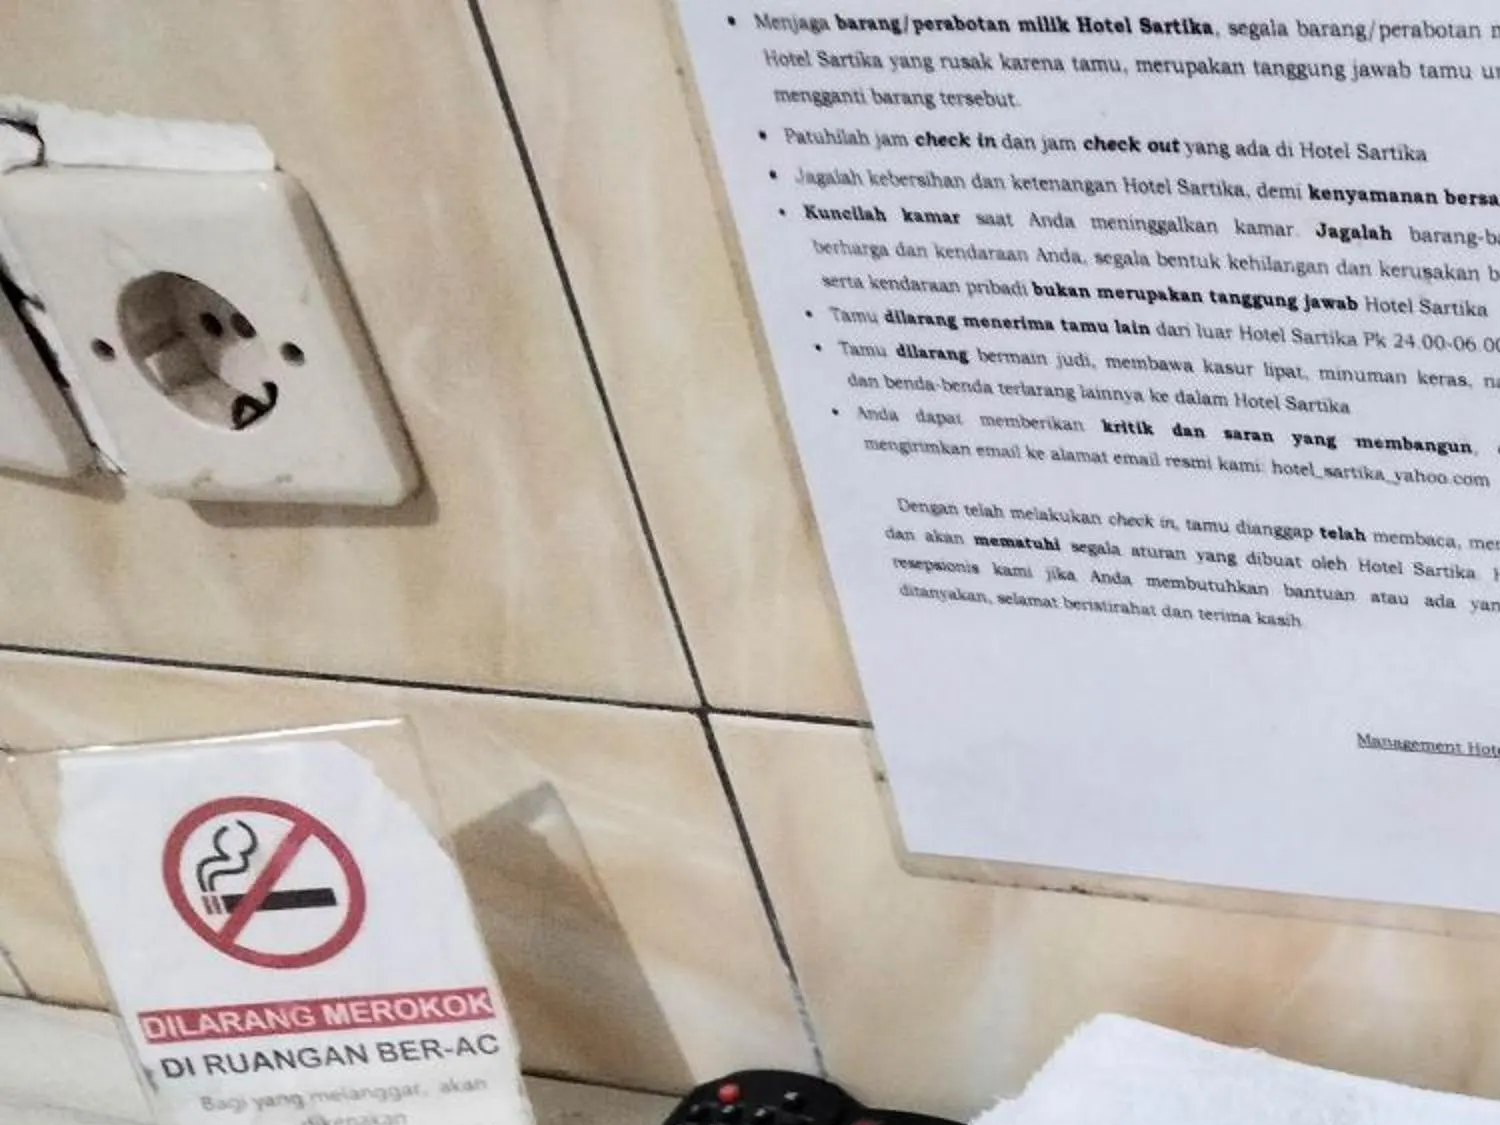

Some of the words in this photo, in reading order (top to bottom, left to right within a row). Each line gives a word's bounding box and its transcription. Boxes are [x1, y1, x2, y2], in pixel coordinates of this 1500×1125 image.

[753, 12, 831, 36] Menjaga
[834, 13, 1011, 36] barang/perabotan
[1017, 15, 1071, 33] milik
[1075, 15, 1133, 34] Hotel
[1138, 16, 1222, 36] Sartika,
[1227, 18, 1289, 41] segala
[1295, 19, 1482, 43] barang/perabotan
[763, 49, 813, 68] Hotel
[816, 49, 884, 69] Sartika
[889, 55, 936, 74] yang
[939, 51, 994, 71] rusak
[998, 52, 1065, 72] karena
[1071, 56, 1129, 75] tamu,
[1135, 56, 1246, 79] merupakan
[1252, 59, 1347, 83] tanggung
[1351, 59, 1412, 83] jawab
[1419, 63, 1472, 80] tamu
[870, 87, 937, 111] barang
[875, 133, 910, 150] jam
[914, 131, 972, 148] check
[976, 132, 998, 149] in
[1001, 132, 1037, 151] dan
[1041, 137, 1077, 155] jam
[1083, 135, 1142, 153] check
[1147, 138, 1181, 154] out
[1183, 141, 1232, 161] yang
[1235, 139, 1271, 158] ada
[1275, 139, 1294, 158] di
[1299, 141, 1351, 160] Hotel
[1356, 143, 1428, 162] Sartika
[866, 169, 966, 189] kebersihan
[970, 172, 1006, 190] dan
[1010, 173, 1118, 197] ketenangan
[1122, 176, 1173, 196] Hotel
[1176, 177, 1252, 199] Sartika,
[1256, 181, 1303, 201] demi
[1307, 183, 1439, 206] kenyamanan
[803, 204, 887, 223] Kuncilah
[901, 207, 961, 225] kamar
[975, 212, 1014, 228] saat
[1029, 211, 1076, 229] Anda
[1090, 214, 1219, 237] meninggalkan
[1315, 222, 1393, 244] Jagalah
[894, 241, 929, 259] dan
[933, 243, 1029, 263] kendaraan
[1093, 249, 1151, 270] segala
[1155, 250, 1221, 270] bentuk
[1335, 258, 1373, 277] dan
[1378, 259, 1481, 283] kerusakan
[867, 274, 961, 294] kendaraan
[1031, 280, 1091, 299] bukan
[1096, 286, 1204, 305] merupakan
[1209, 290, 1299, 313] tanggung
[1303, 293, 1359, 313] jawab
[1364, 295, 1414, 314] Hotel
[1419, 298, 1489, 318] Sartika
[884, 309, 959, 331] dilarang
[962, 315, 1055, 331] menerima
[1060, 319, 1109, 334] tamu
[1113, 319, 1151, 336] lain
[1239, 325, 1287, 344] Hotel
[1290, 327, 1358, 347] Sartika
[1362, 331, 1387, 349] Pk
[895, 343, 970, 366] dilarang
[1104, 355, 1195, 374] membawa
[1202, 358, 1254, 376] kasur
[1318, 368, 1407, 385] minuman
[847, 372, 880, 389] dan
[1149, 388, 1169, 404] ke
[1174, 389, 1229, 407] dalam
[1233, 392, 1281, 411] Hotel
[1284, 395, 1351, 415] Sartika
[857, 405, 900, 423] Anda
[1101, 418, 1155, 436] kritik
[1171, 422, 1206, 439] dan
[1223, 429, 1275, 443] saran
[1291, 433, 1338, 451] yang
[1108, 511, 1155, 529] check
[1185, 518, 1230, 534] tamu
[1319, 525, 1367, 543] telah
[973, 535, 1061, 552] mematuhi
[1245, 551, 1303, 569] dibuat
[1311, 555, 1348, 572] oleh
[1358, 558, 1403, 575] Hotel
[1091, 569, 1133, 587] Anda
[1370, 592, 1409, 606] atau
[1423, 593, 1457, 609] ada
[1356, 732, 1463, 755] Management
[141, 1005, 316, 1040] DILARANG
[322, 993, 494, 1027] MEROKOK
[160, 1055, 196, 1080] DI
[203, 1043, 370, 1076] RUANGAN
[376, 1033, 500, 1064] BER-AC
[252, 1091, 305, 1111] yang
[438, 1077, 489, 1094] akan
